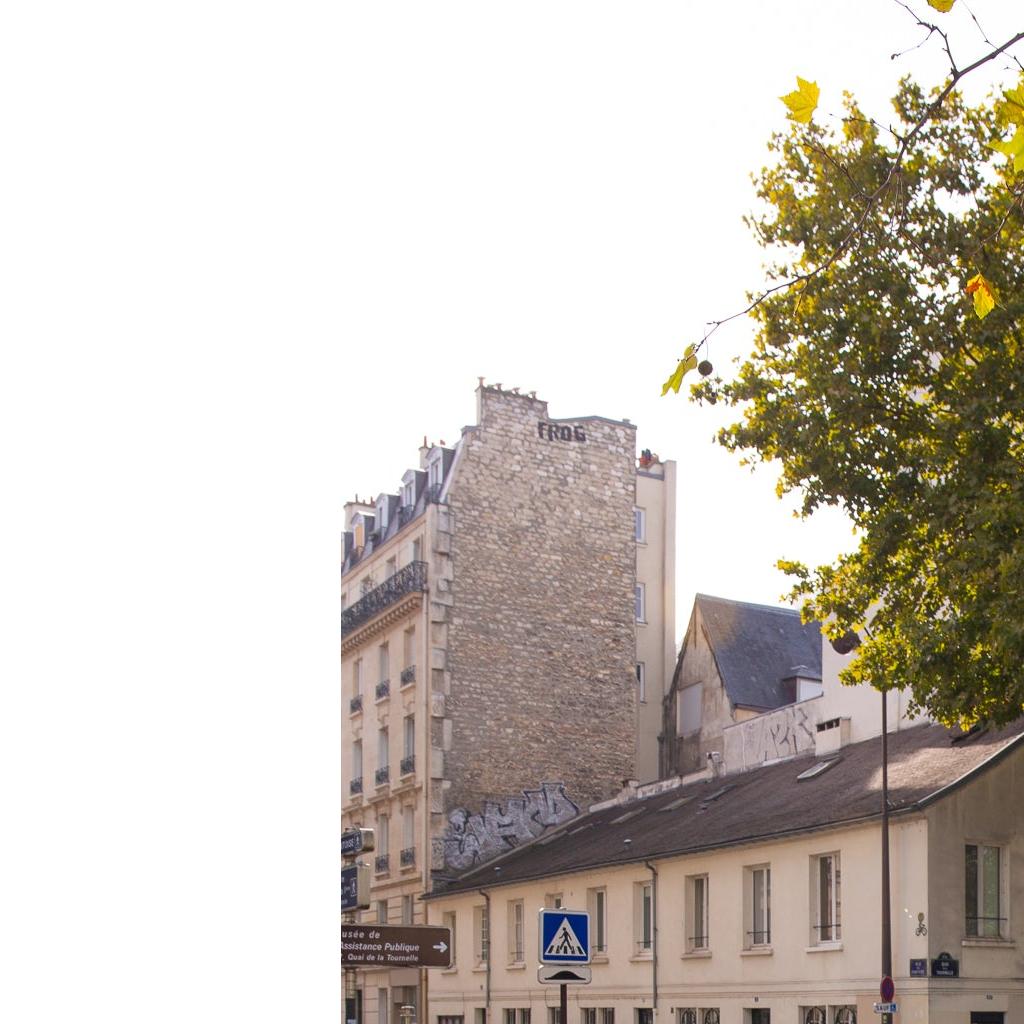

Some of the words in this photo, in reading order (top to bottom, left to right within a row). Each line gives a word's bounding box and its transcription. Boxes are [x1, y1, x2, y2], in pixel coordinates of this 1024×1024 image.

[538, 421, 586, 442] FROG
[369, 930, 381, 939] de
[384, 942, 420, 953] Publique
[347, 953, 364, 961] Quai
[366, 953, 376, 961] de
[387, 954, 419, 962] Tournelle
